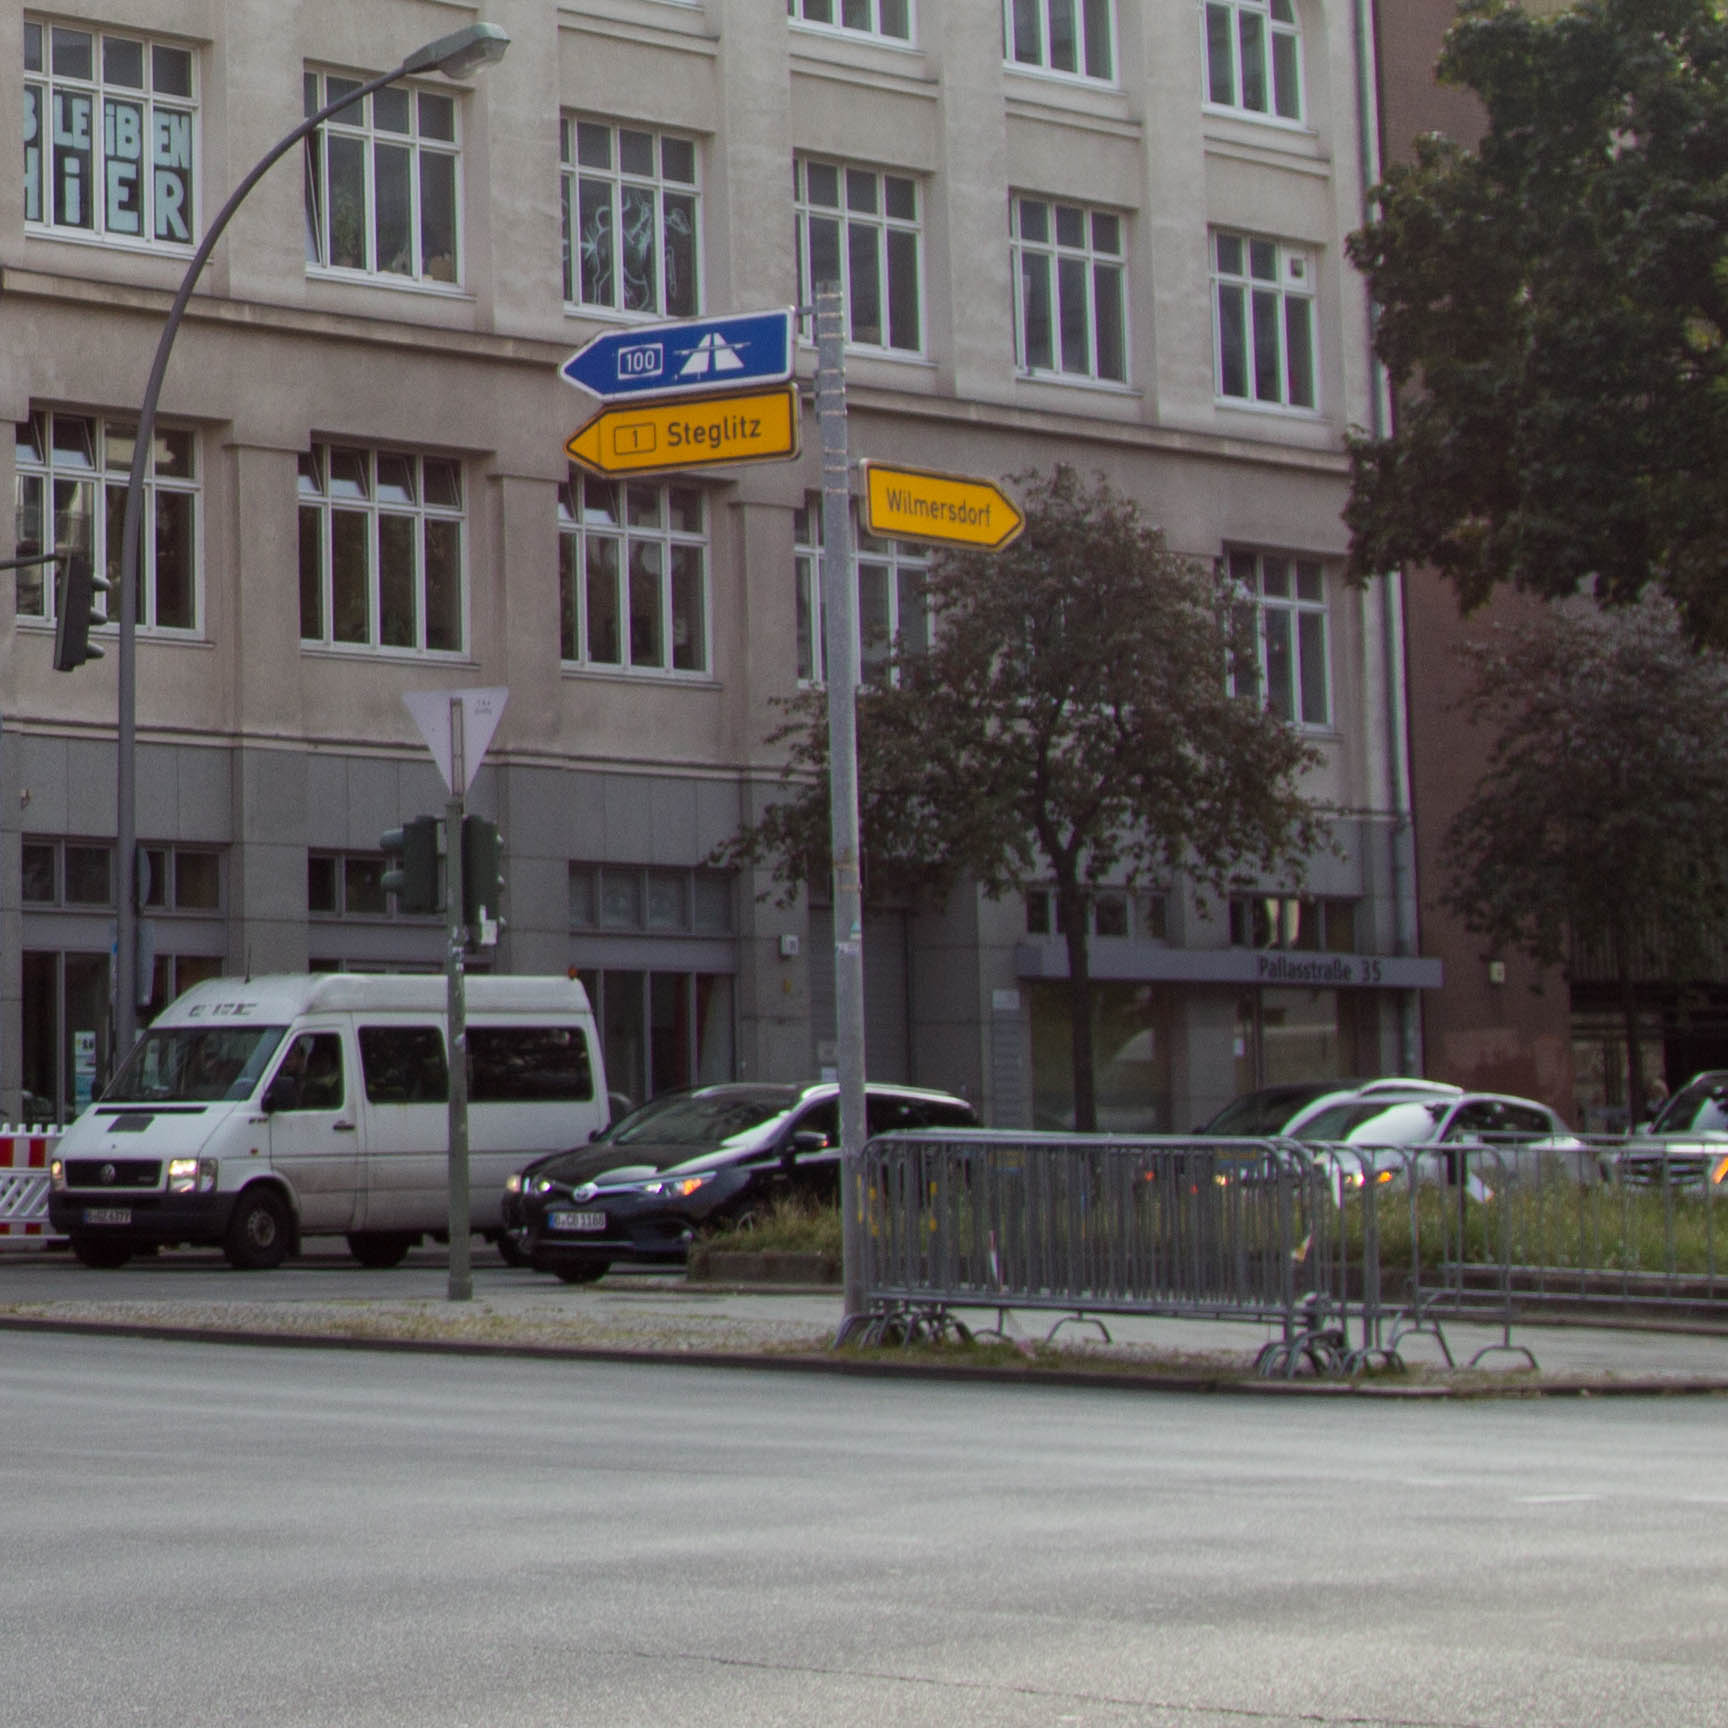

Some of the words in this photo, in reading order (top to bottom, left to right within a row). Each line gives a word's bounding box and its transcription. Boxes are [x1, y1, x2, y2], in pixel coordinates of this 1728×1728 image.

[626, 351, 655, 372] 100
[633, 430, 639, 448] 1
[667, 416, 762, 448] Steglitz
[886, 487, 991, 527] Wilmersdorf
[1257, 954, 1352, 982] Pallasstraße
[1361, 960, 1382, 982] 35
